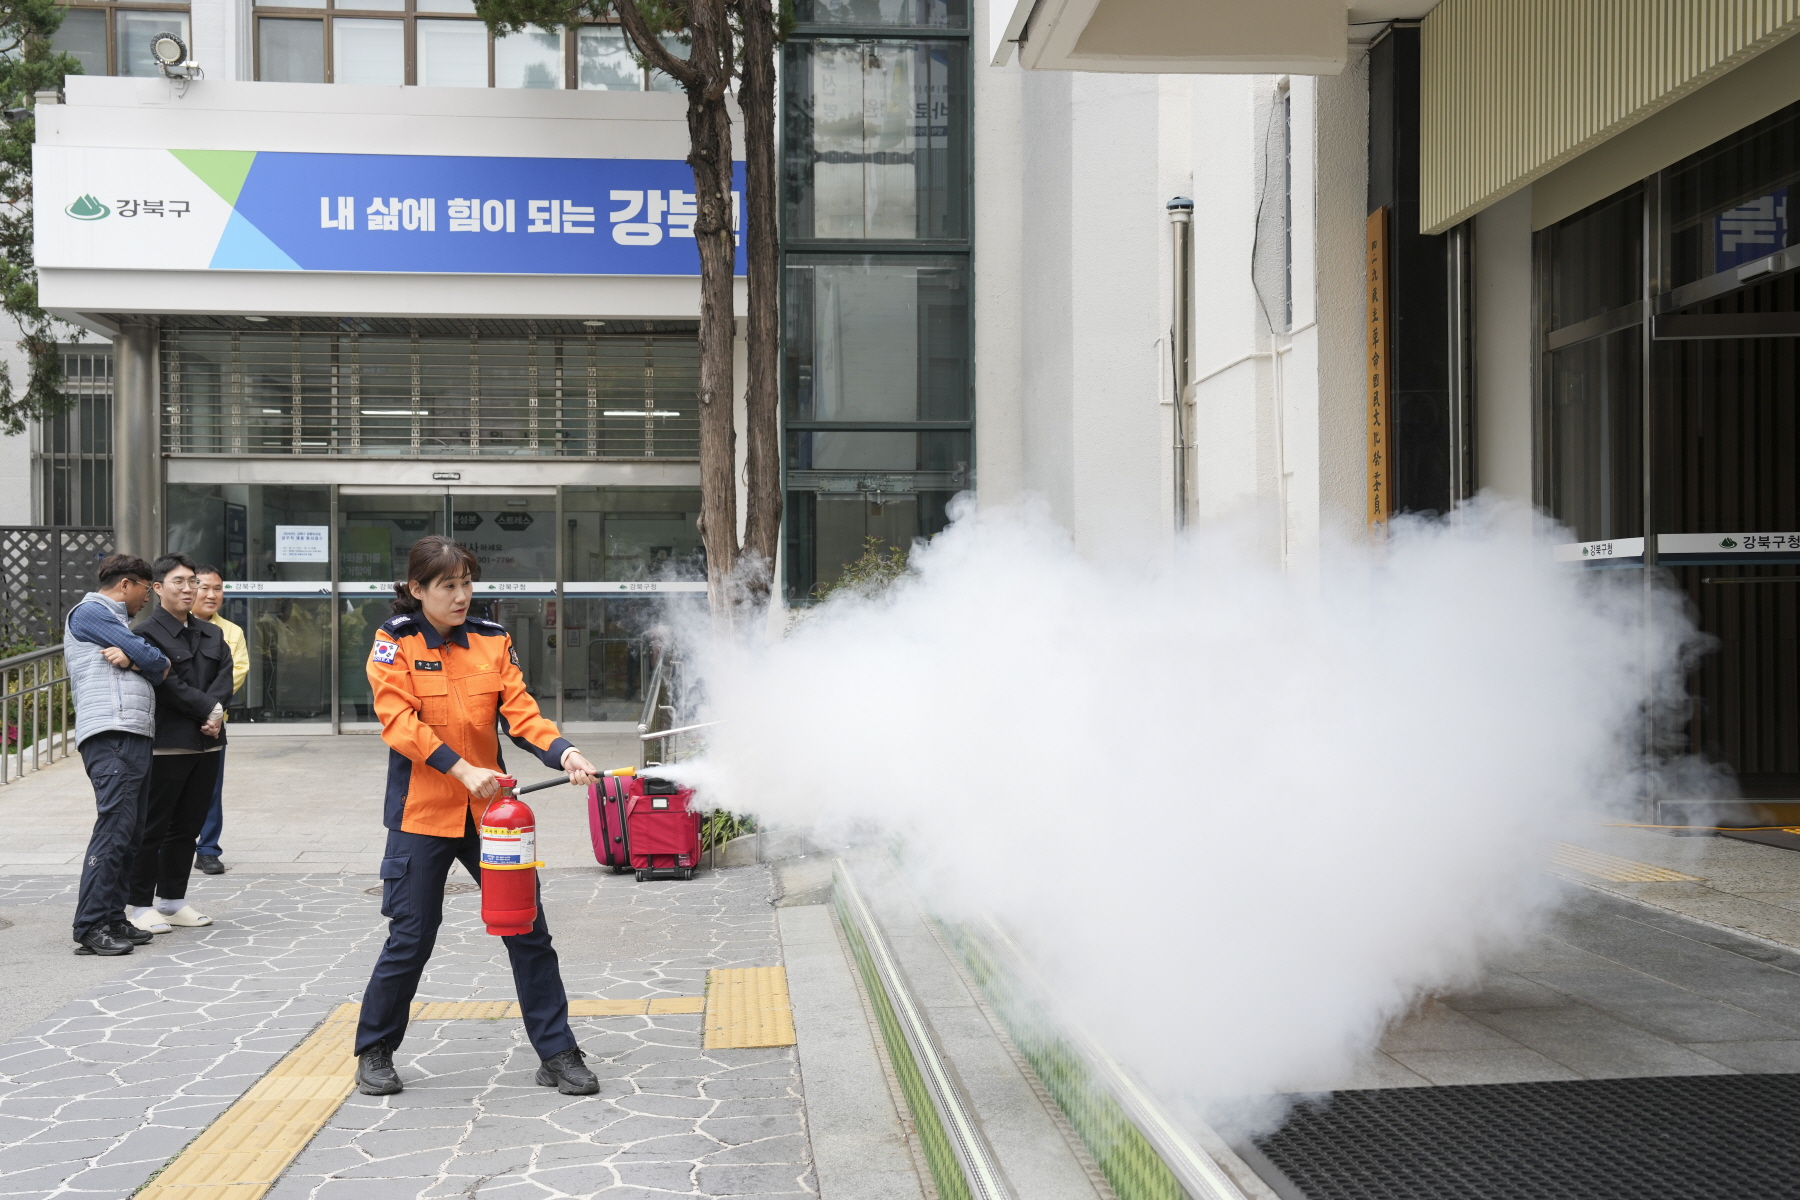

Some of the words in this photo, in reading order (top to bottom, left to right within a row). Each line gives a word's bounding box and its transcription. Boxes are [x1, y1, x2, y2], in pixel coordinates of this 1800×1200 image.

[116, 199, 191, 218] 강북구
[320, 196, 354, 230] 내
[366, 197, 435, 231] 삶에
[447, 197, 515, 232] 힘이
[527, 199, 595, 233] 되는
[498, 515, 531, 525] 스트레스
[1590, 542, 1613, 556] 강북구청
[1742, 535, 1800, 549] 강북구청
